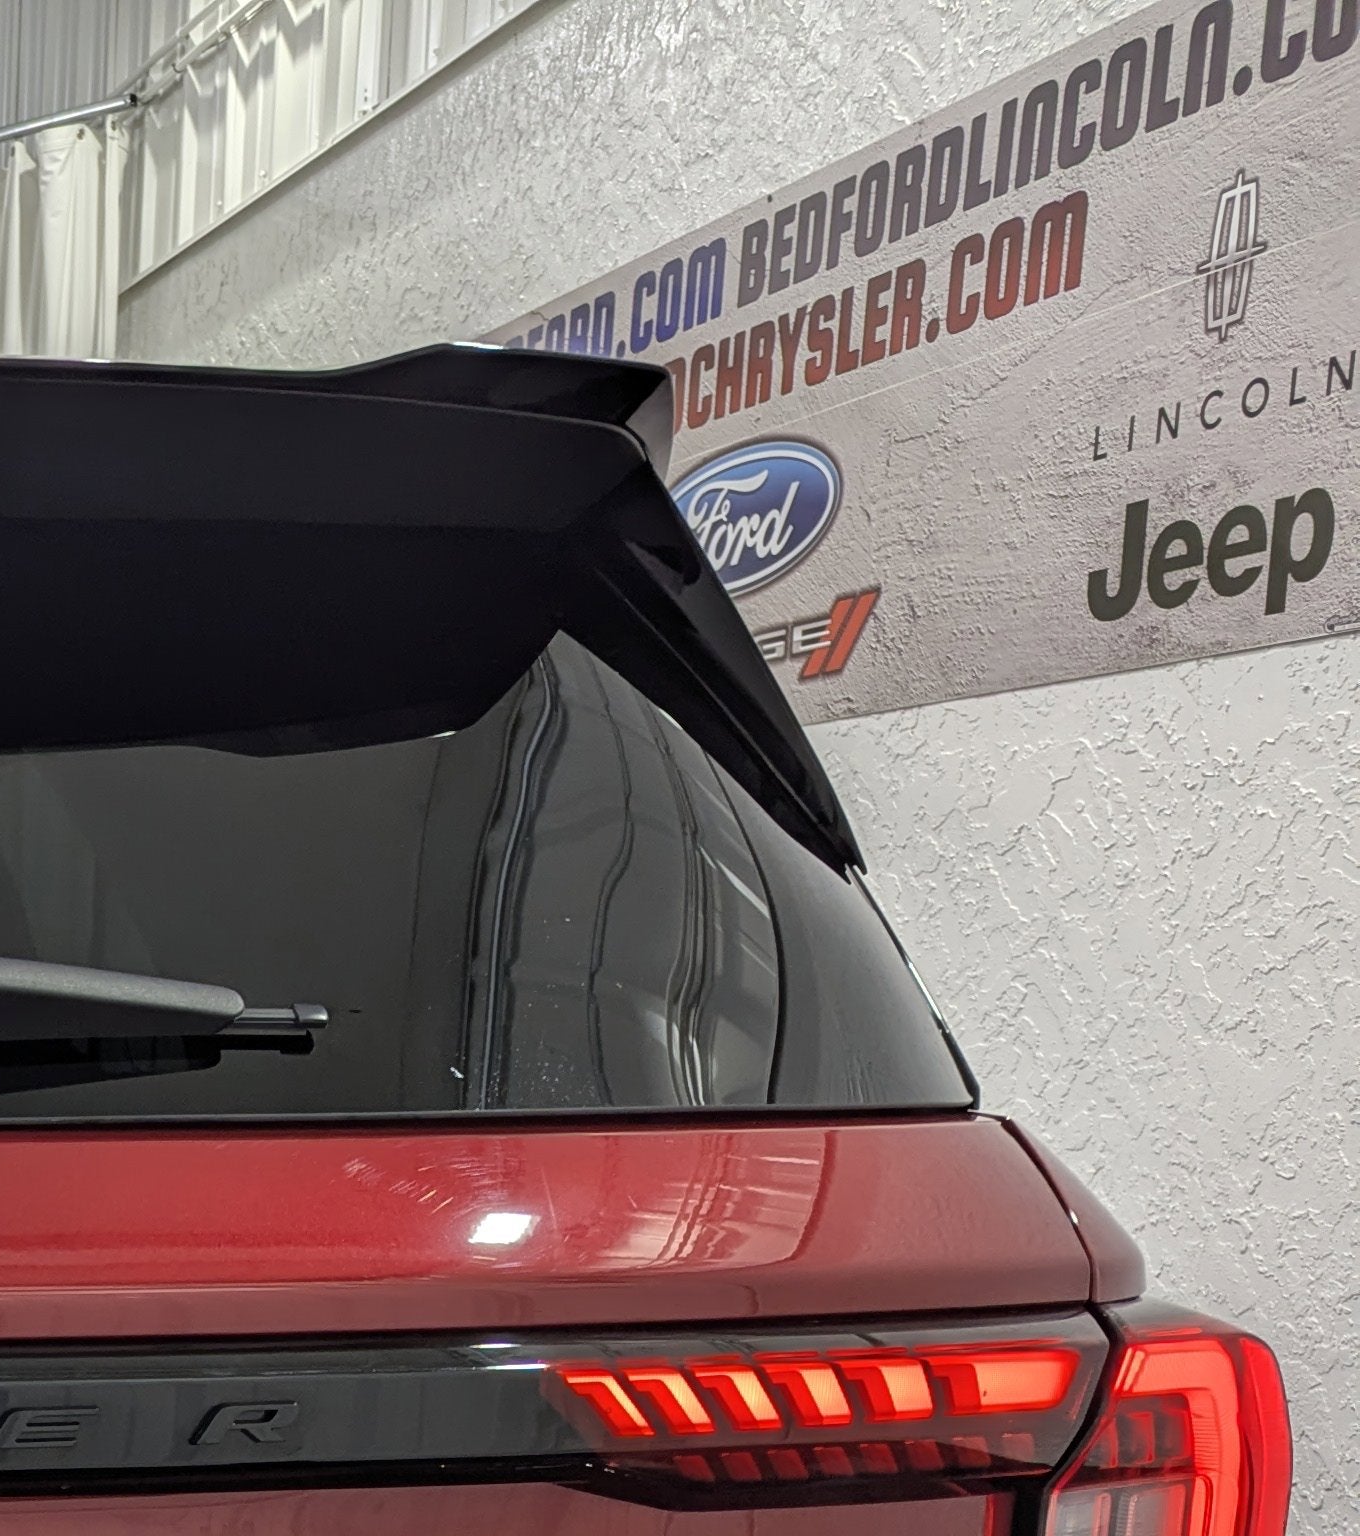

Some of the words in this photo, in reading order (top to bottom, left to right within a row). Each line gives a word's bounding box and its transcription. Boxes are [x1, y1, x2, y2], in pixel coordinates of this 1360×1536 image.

[1093, 350, 1357, 461] LINCOLN
[686, 468, 800, 572] Ford
[1087, 487, 1336, 622] Jeep
